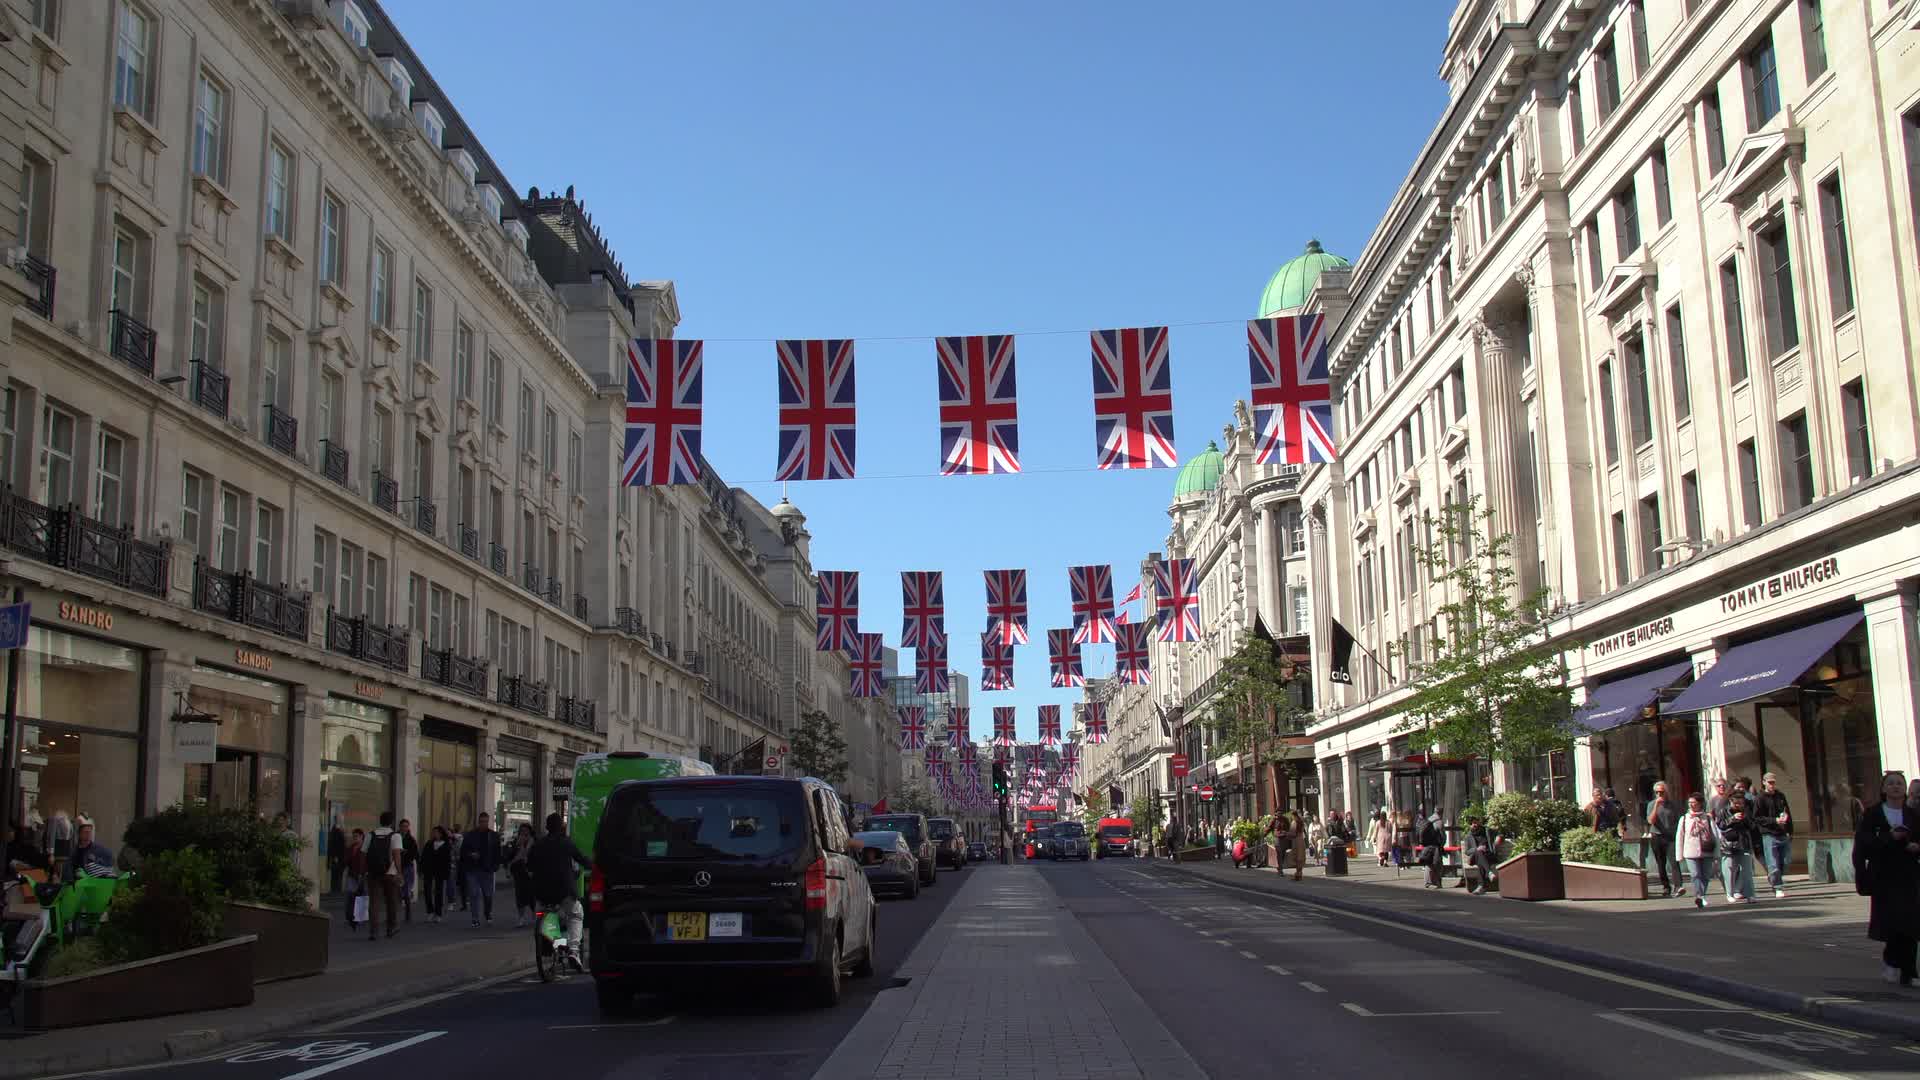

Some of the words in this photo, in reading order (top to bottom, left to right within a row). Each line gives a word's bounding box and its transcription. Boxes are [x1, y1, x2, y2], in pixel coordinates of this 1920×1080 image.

[1720, 583, 1765, 613] TOMMY
[1783, 557, 1840, 592] HILFIGER
[59, 601, 113, 630] SANDRO
[1594, 634, 1626, 657] TOMMY
[1636, 617, 1674, 642] HILFIGER
[236, 649, 273, 671] SANDRO
[1331, 666, 1350, 682] alo
[1305, 784, 1319, 795] alo
